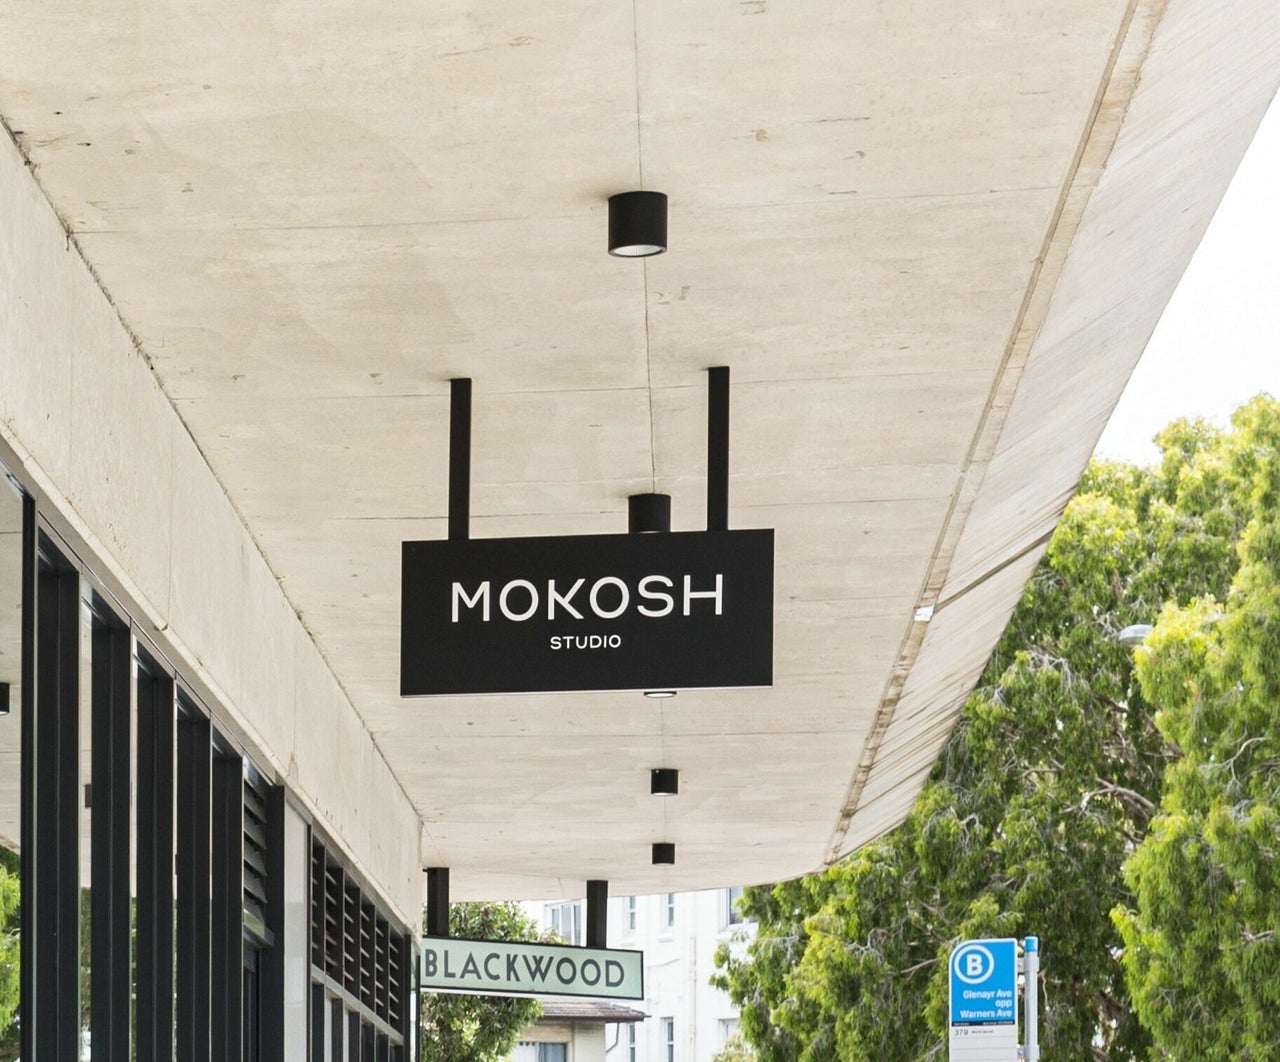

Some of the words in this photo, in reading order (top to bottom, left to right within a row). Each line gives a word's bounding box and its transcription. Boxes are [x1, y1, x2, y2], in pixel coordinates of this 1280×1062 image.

[451, 573, 724, 623] MOKOSH
[550, 634, 621, 650] STUDIO
[425, 949, 625, 988] BLACKWOOD
[966, 953, 983, 976] B
[963, 990, 995, 1000] Glenayr
[996, 989, 1013, 998] Ave
[995, 999, 1013, 1008] opp
[960, 1010, 995, 1018] Warners
[996, 1009, 1013, 1017] Ave
